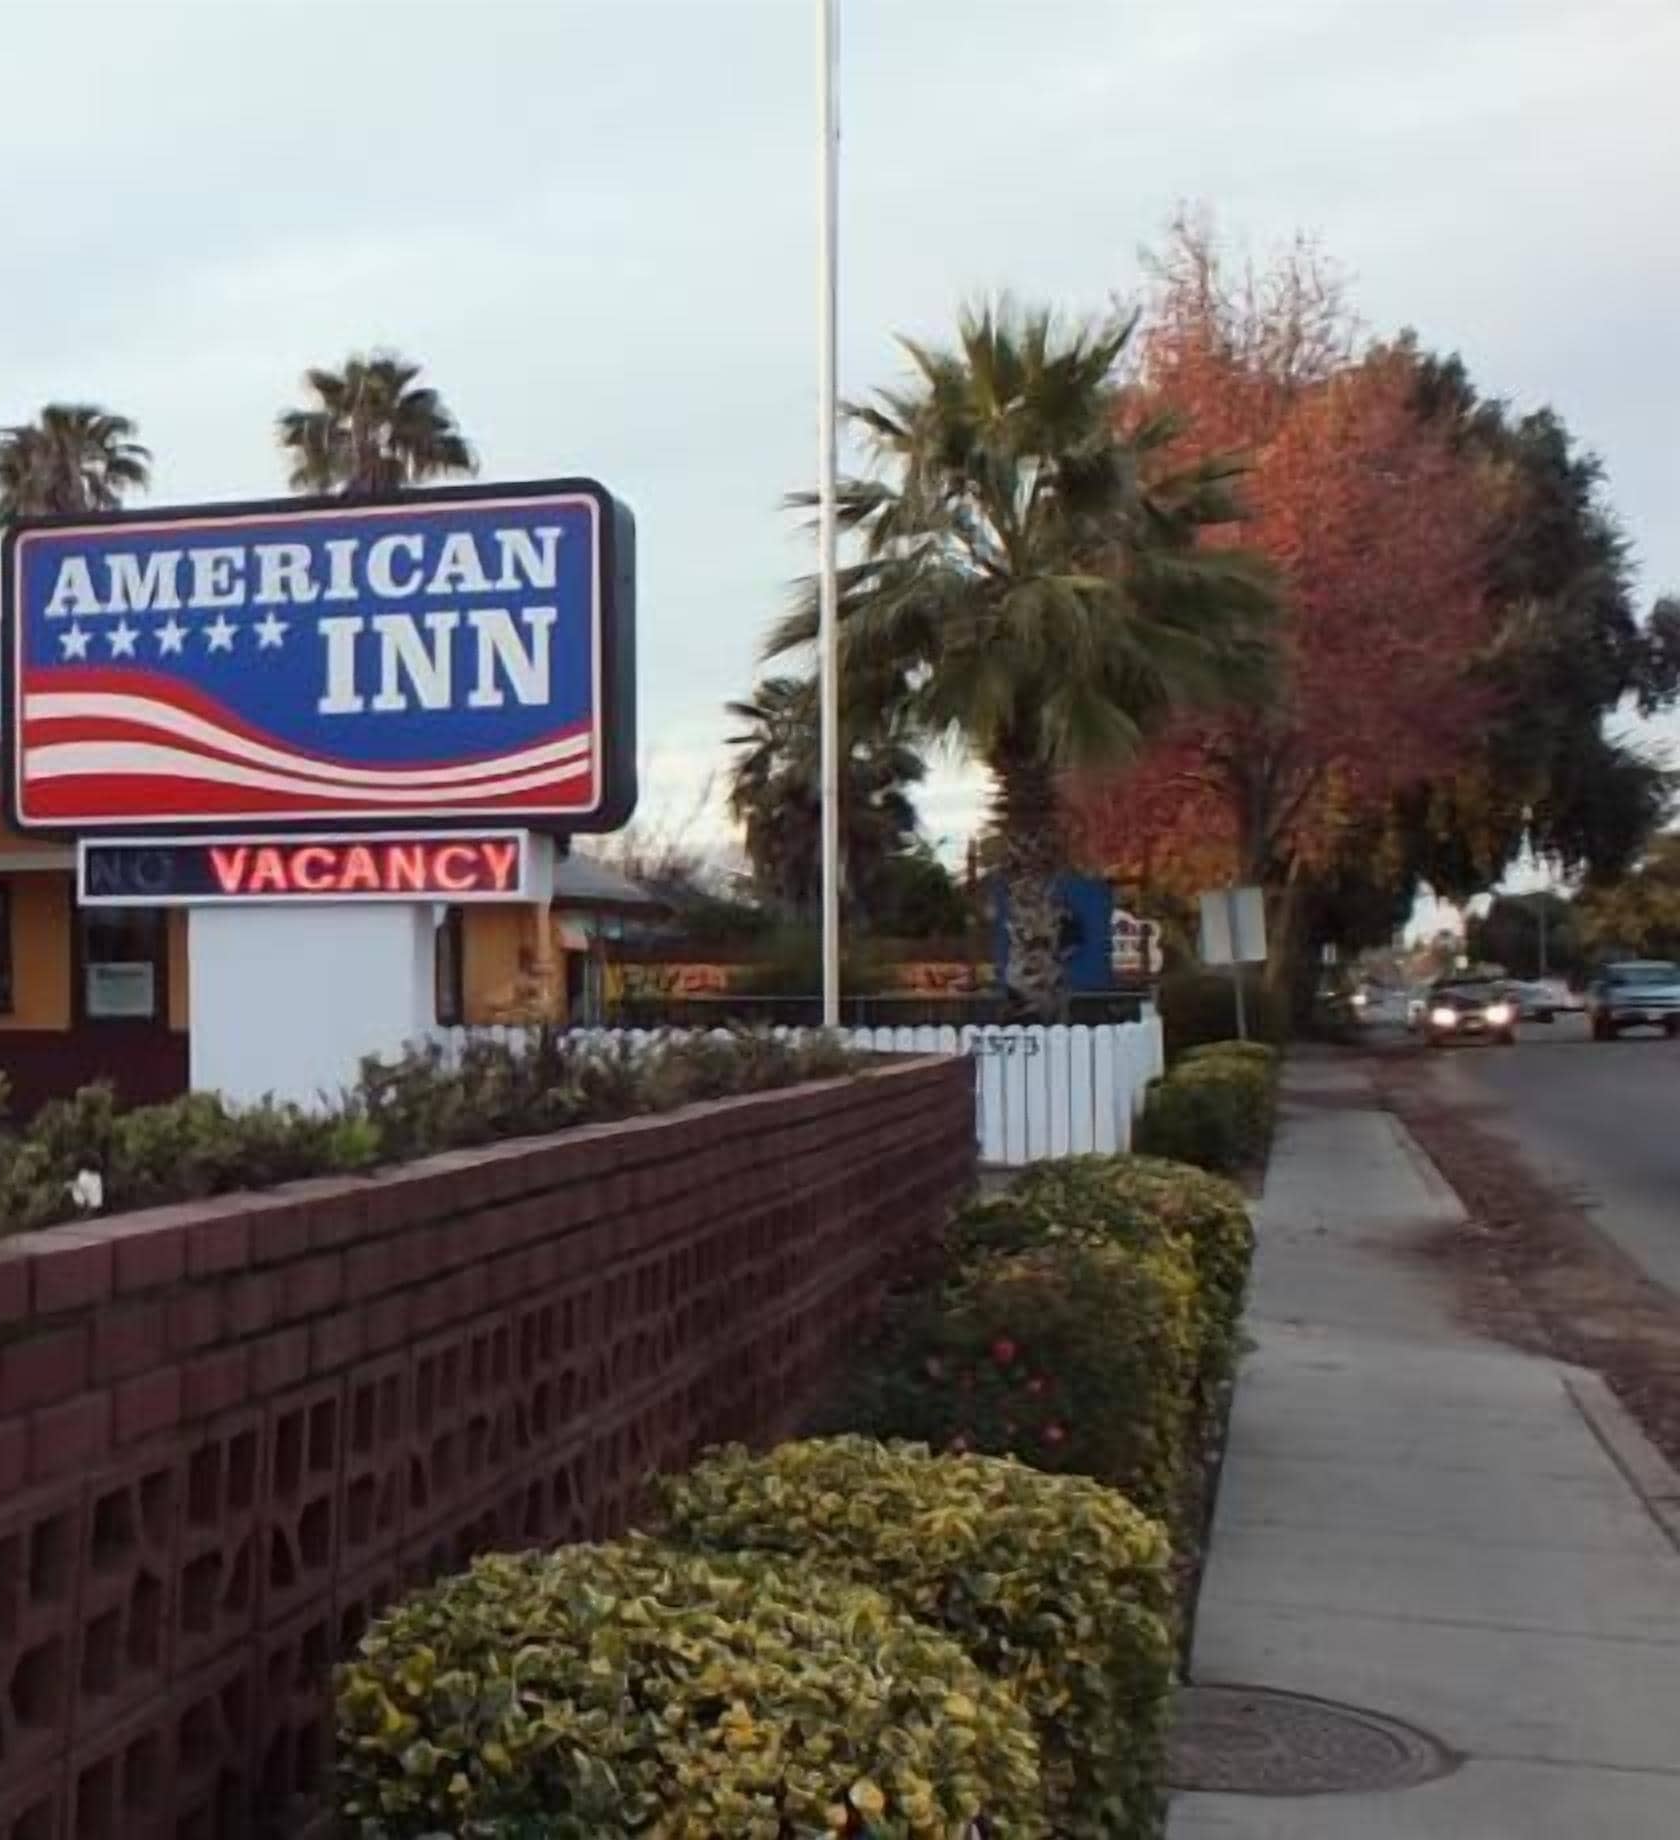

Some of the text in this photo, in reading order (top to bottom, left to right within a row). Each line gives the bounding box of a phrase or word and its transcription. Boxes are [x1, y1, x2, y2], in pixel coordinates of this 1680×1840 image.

[44, 527, 562, 617] AMERICAN
[318, 607, 557, 714] INN
[90, 844, 517, 893] NO VACANCY
